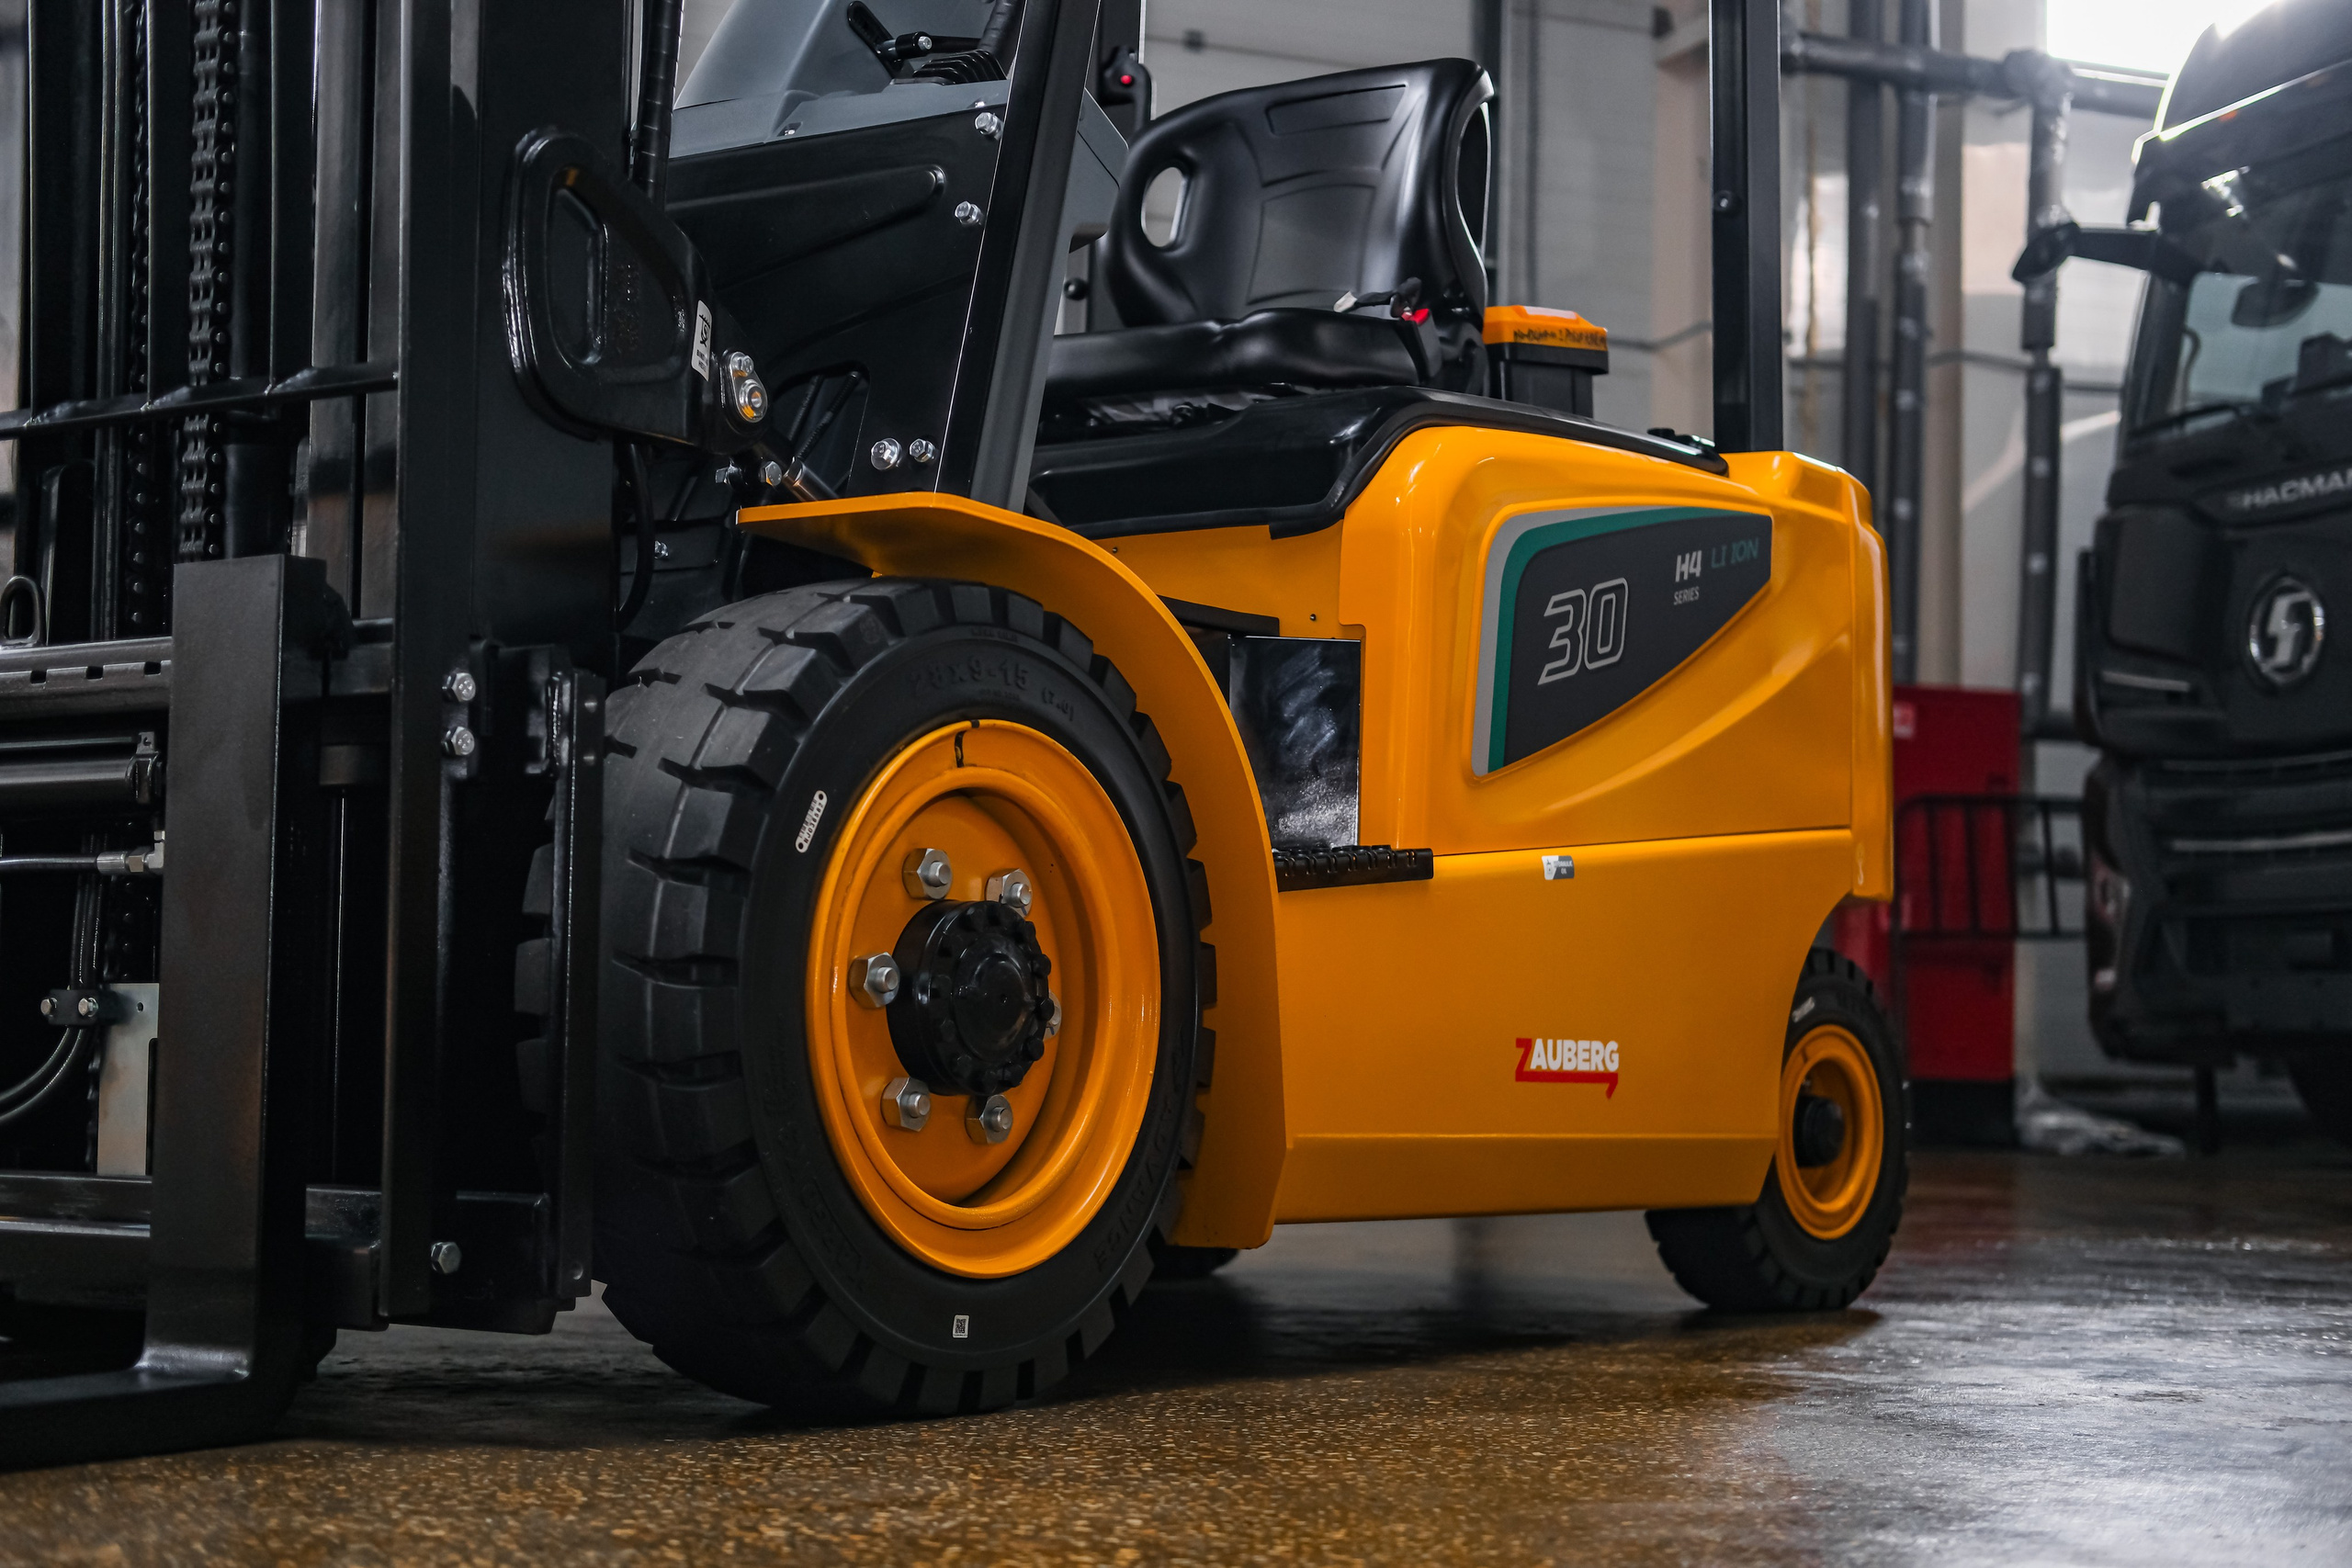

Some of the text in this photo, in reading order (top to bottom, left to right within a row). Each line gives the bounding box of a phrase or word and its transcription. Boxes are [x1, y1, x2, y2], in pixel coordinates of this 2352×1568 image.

[2226, 468, 2352, 509] HACMA
[1675, 536, 1759, 582] H4 LI ION
[1673, 586, 1700, 605] SERIES
[1537, 577, 1629, 685] 30
[1515, 1037, 1620, 1100] ZAUBERG
